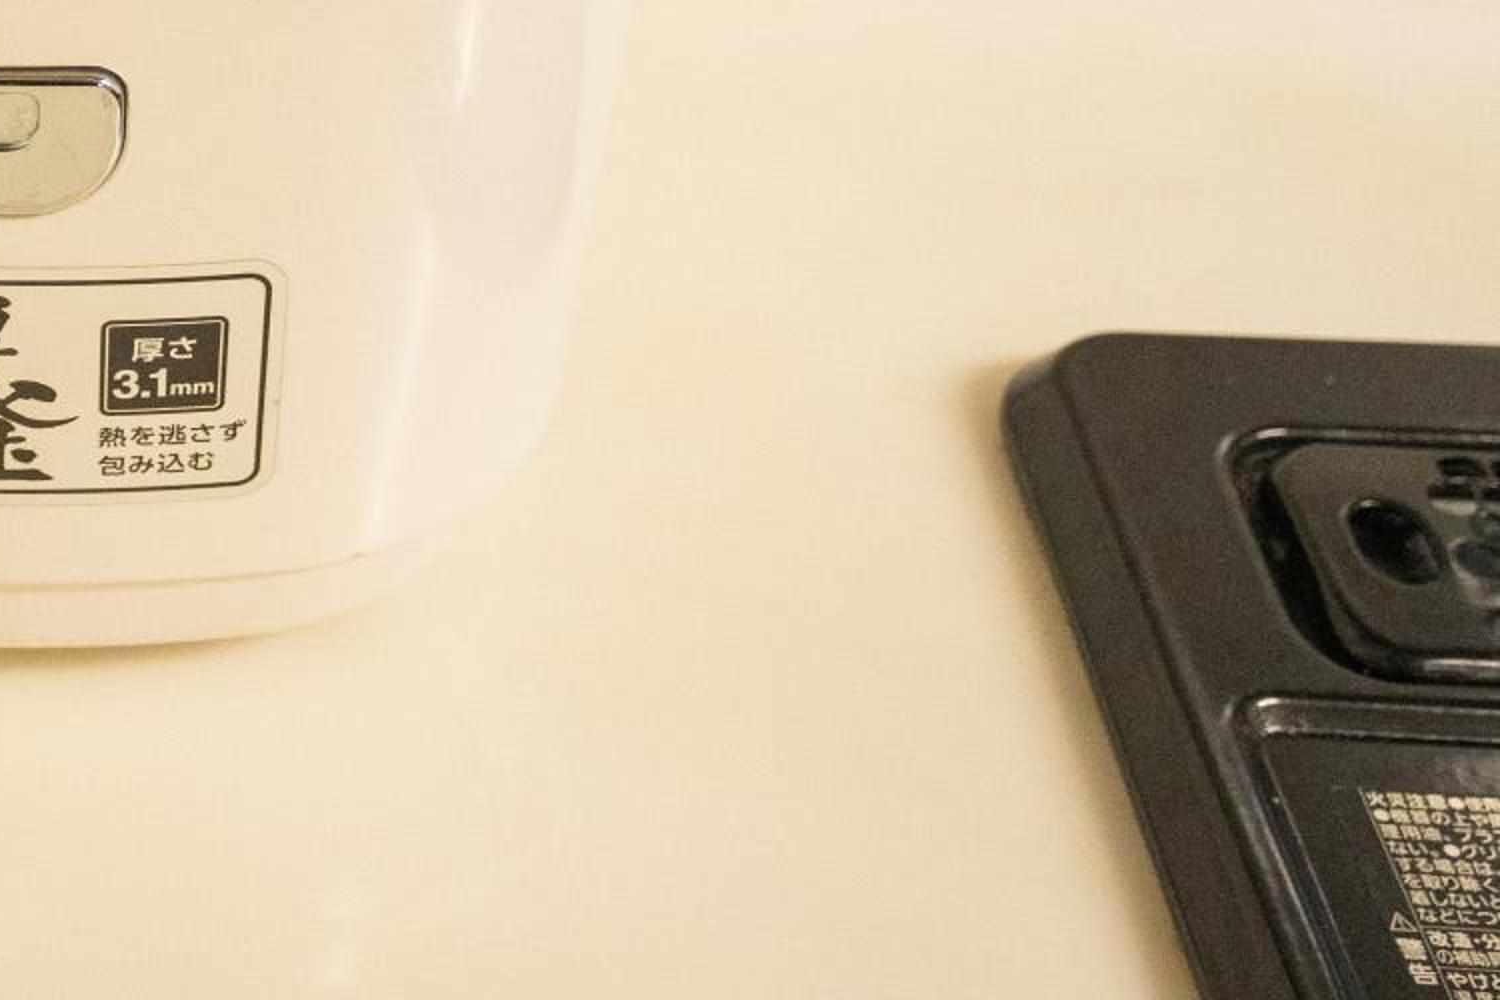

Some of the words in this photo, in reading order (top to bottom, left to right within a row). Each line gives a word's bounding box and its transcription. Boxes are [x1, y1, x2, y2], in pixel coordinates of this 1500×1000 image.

[131, 336, 197, 363] 厚さ
[112, 367, 216, 400] 3.1mm
[98, 418, 248, 449] 熱を逃さず
[98, 451, 214, 477] 包み込む
